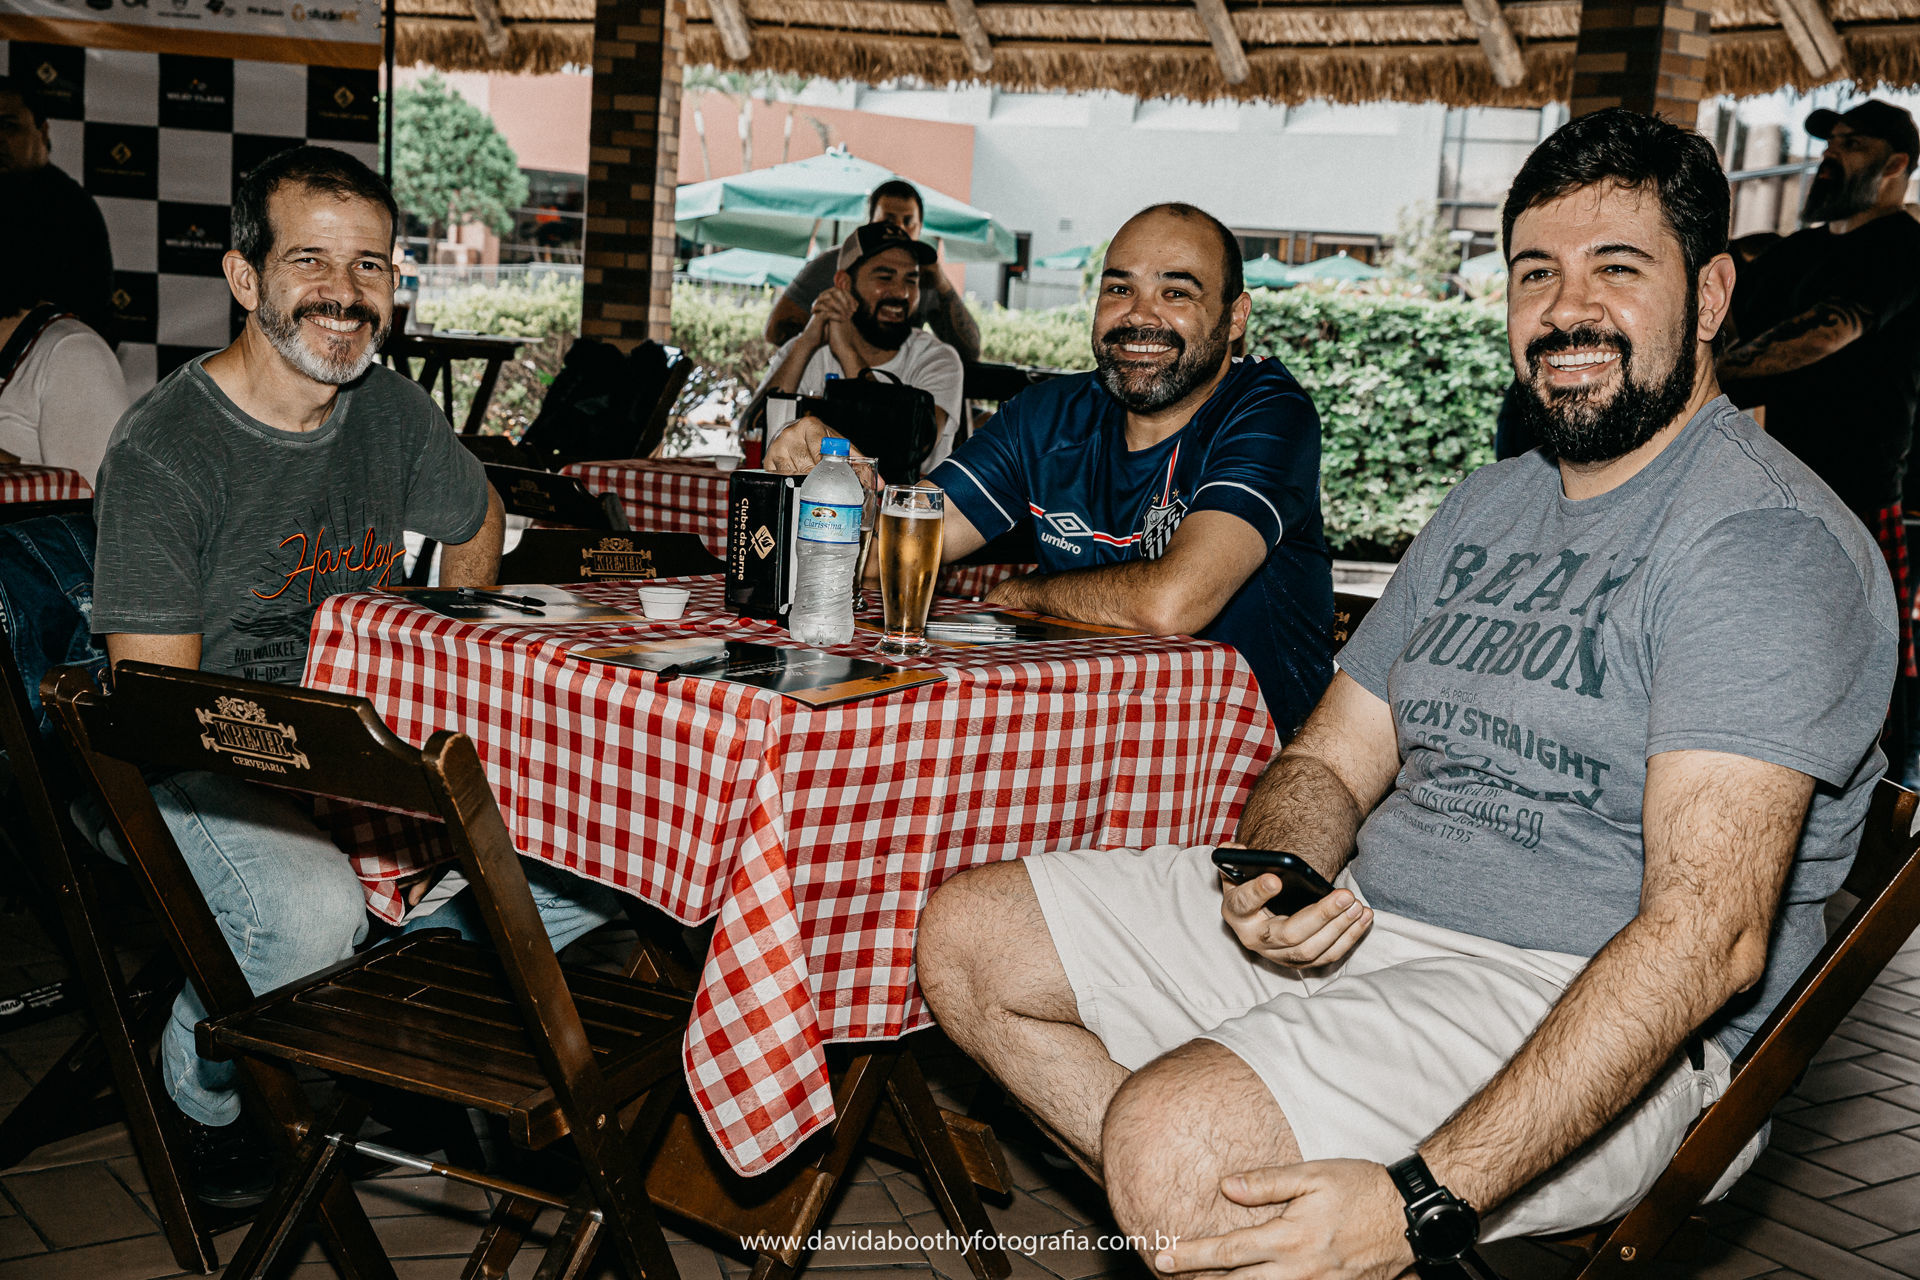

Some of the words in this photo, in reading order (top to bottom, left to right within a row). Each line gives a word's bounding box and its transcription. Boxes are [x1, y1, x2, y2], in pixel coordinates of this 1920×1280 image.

[739, 497, 749, 530] Clube
[739, 531, 748, 547] da
[1041, 532, 1082, 555] umbro
[251, 527, 406, 604] Harley
[737, 547, 747, 581] Carne
[1402, 611, 1605, 699] OURBON
[214, 720, 291, 758] KREMER
[1458, 707, 1611, 786] STRAIGHT
[232, 755, 287, 774] CERVEJARIA
